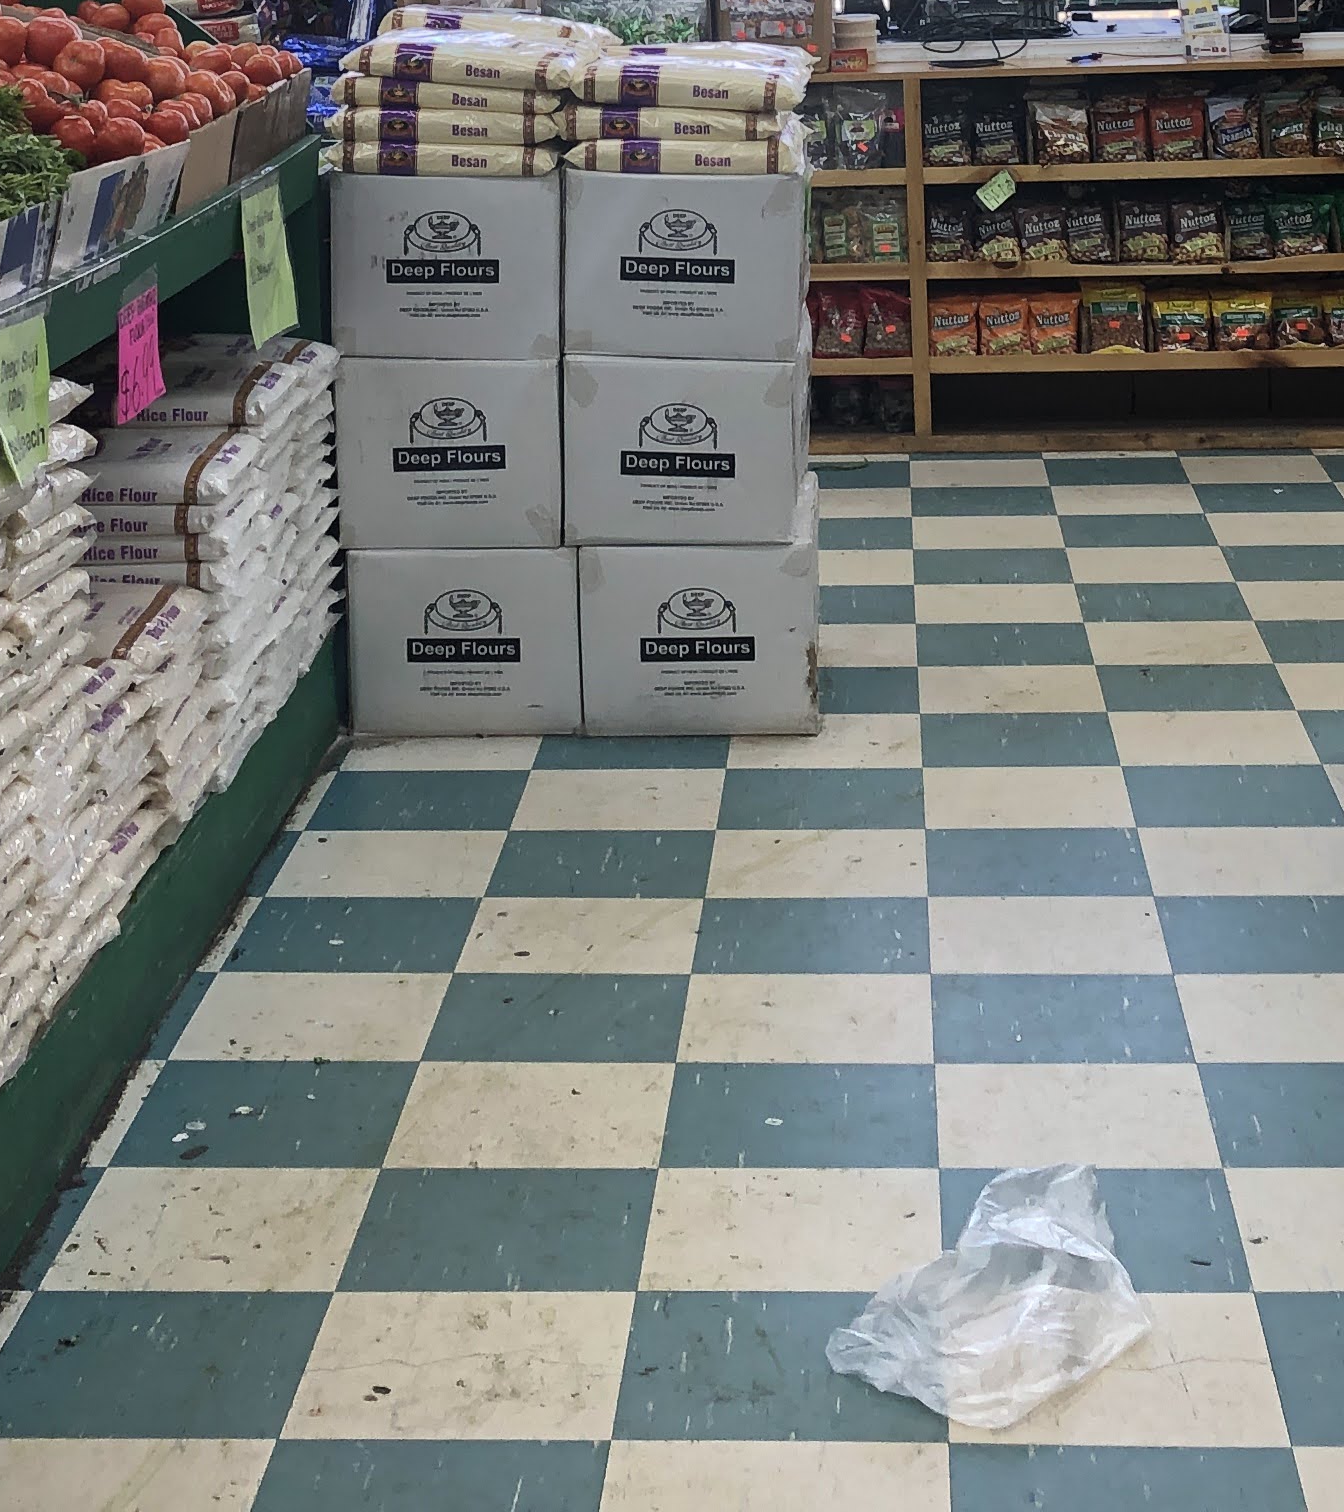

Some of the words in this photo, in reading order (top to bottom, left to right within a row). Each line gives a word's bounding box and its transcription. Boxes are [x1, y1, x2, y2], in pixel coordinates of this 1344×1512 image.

[465, 64, 500, 79] Besan
[693, 85, 729, 99] Besan
[451, 93, 488, 108] Besan
[451, 124, 488, 137] Besan
[674, 122, 711, 135] Besan
[924, 121, 961, 135] Nuttoz
[976, 120, 1013, 134] Nuttoz
[1097, 118, 1135, 132] Nuttoz
[1156, 117, 1192, 130] Nuttoz
[451, 154, 487, 168] Besan
[694, 153, 732, 168] Besan
[978, 218, 1012, 235] Nuttoz
[1025, 219, 1061, 234] Nuttoz
[1124, 213, 1162, 227] Nuttoz
[1180, 213, 1216, 229] Nuttoz
[1275, 214, 1313, 230] Nuttoz
[391, 262, 435, 279] Deep
[440, 261, 495, 278] Flours
[625, 260, 670, 278] Deep
[675, 261, 730, 278] Flours
[933, 314, 969, 328] Nuttoz
[985, 311, 1021, 327] Nuttoz
[0, 356, 19, 384] Deep
[136, 408, 168, 423] Rice
[172, 407, 209, 423] Flour
[398, 450, 442, 467] Deep
[446, 449, 502, 465] Flours
[625, 453, 670, 472] Deep
[675, 455, 730, 471] Flours
[81, 488, 114, 503] Rice
[119, 488, 158, 503] Flour
[110, 518, 148, 533] Flour
[83, 546, 116, 561] Rice
[120, 545, 159, 560] Flour
[412, 641, 456, 658] Deep
[461, 640, 516, 656] Flours
[645, 640, 690, 657] Deep
[694, 640, 751, 656] Flours
